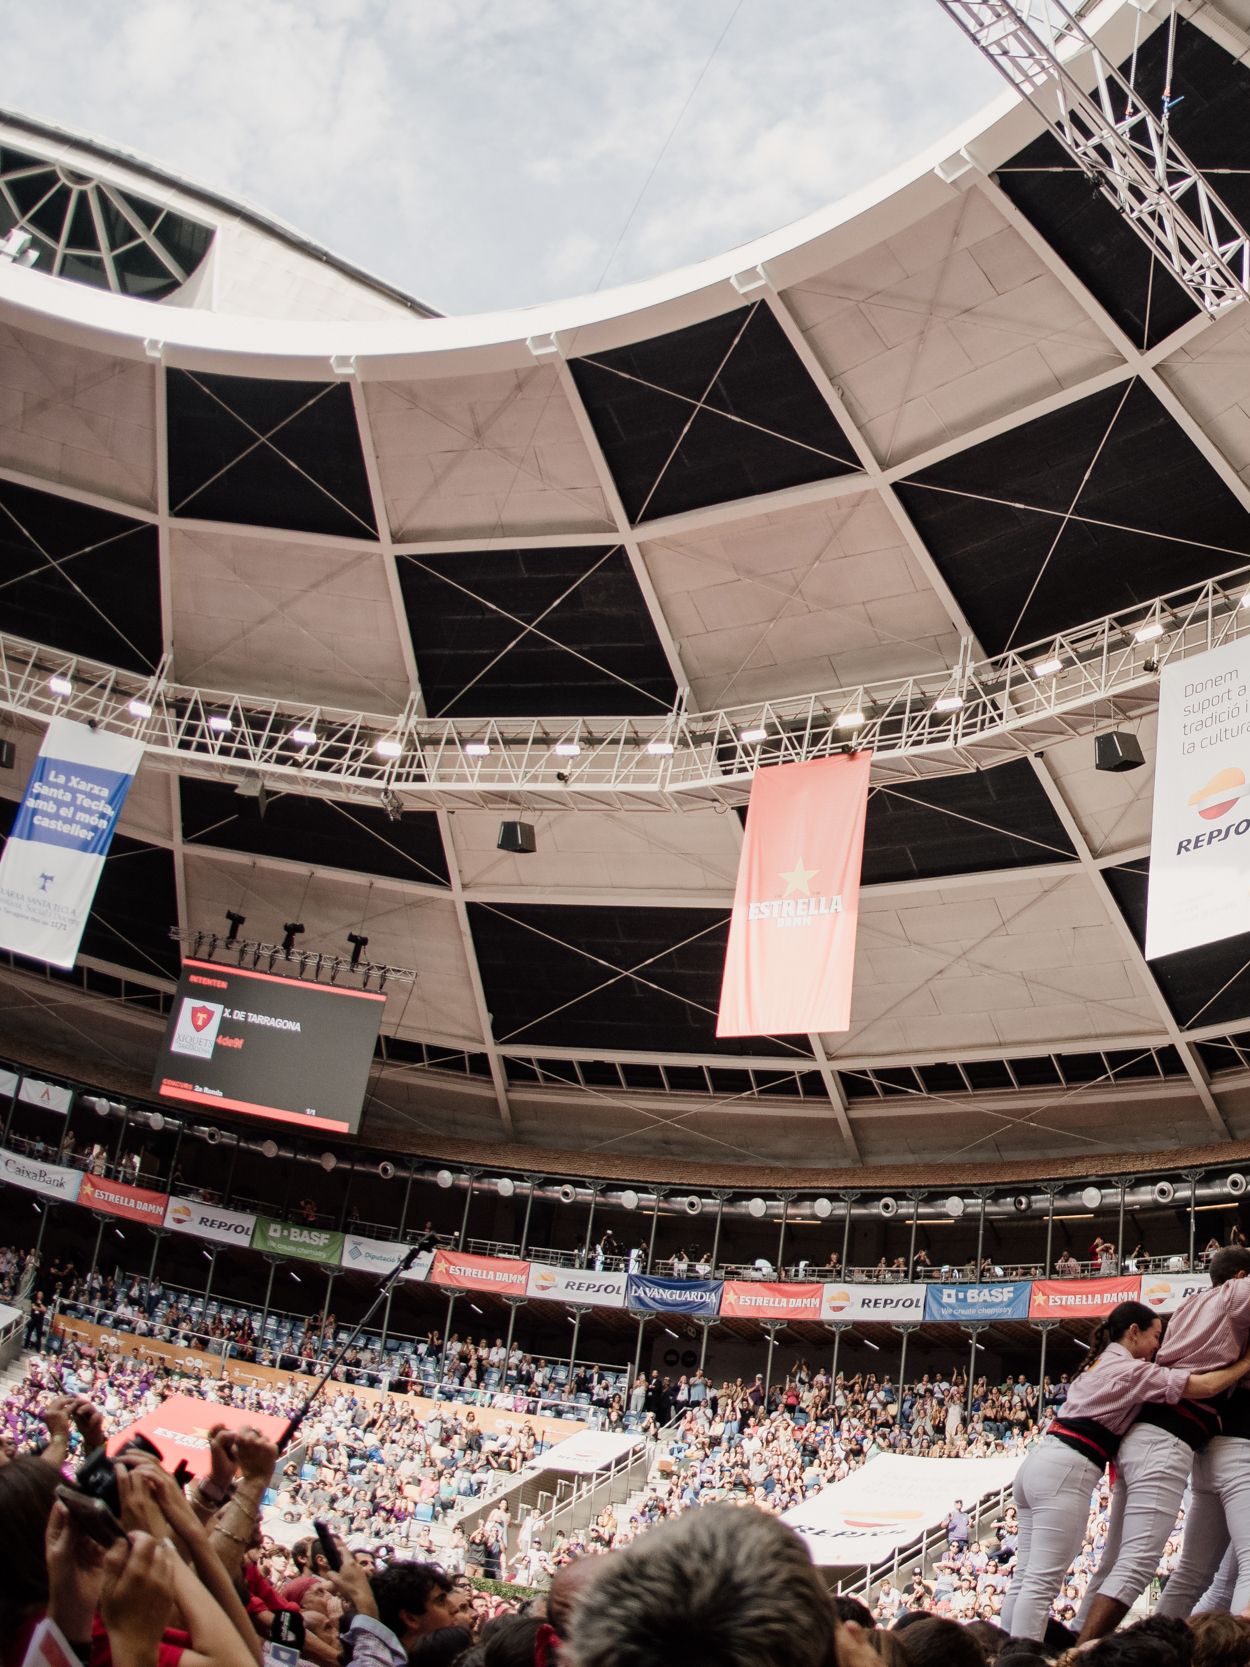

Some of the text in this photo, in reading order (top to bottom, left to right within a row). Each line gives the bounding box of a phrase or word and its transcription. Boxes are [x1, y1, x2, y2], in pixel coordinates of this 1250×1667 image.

[1184, 669, 1239, 698] Donem
[1183, 688, 1232, 717] suport
[1237, 685, 1247, 697] a
[1182, 702, 1240, 736] tradició
[1182, 742, 1196, 756] la
[32, 781, 72, 802] Santa
[48, 770, 109, 798] La Xarxa
[25, 797, 108, 830] amb el món
[33, 815, 95, 840] casteller
[748, 895, 843, 921] ESTRELLA
[233, 1010, 246, 1021] DE
[247, 1012, 301, 1033] TARRAGONA
[5, 1159, 66, 1190] CaixaBank
[94, 1189, 164, 1215] ESTRELLA DAMM
[198, 1216, 250, 1237] REPSOL
[290, 1227, 330, 1246] BASF
[449, 1266, 526, 1283] ESTRELLA DAMM
[564, 1280, 623, 1296] REPSOL
[631, 1286, 717, 1303] LA VANGUARDIA
[967, 1287, 1014, 1303] BASF
[1048, 1291, 1138, 1306] ESTRELLA DAMM
[739, 1295, 820, 1308] ESTRELLA DAMM
[860, 1298, 922, 1309] REPSOL
